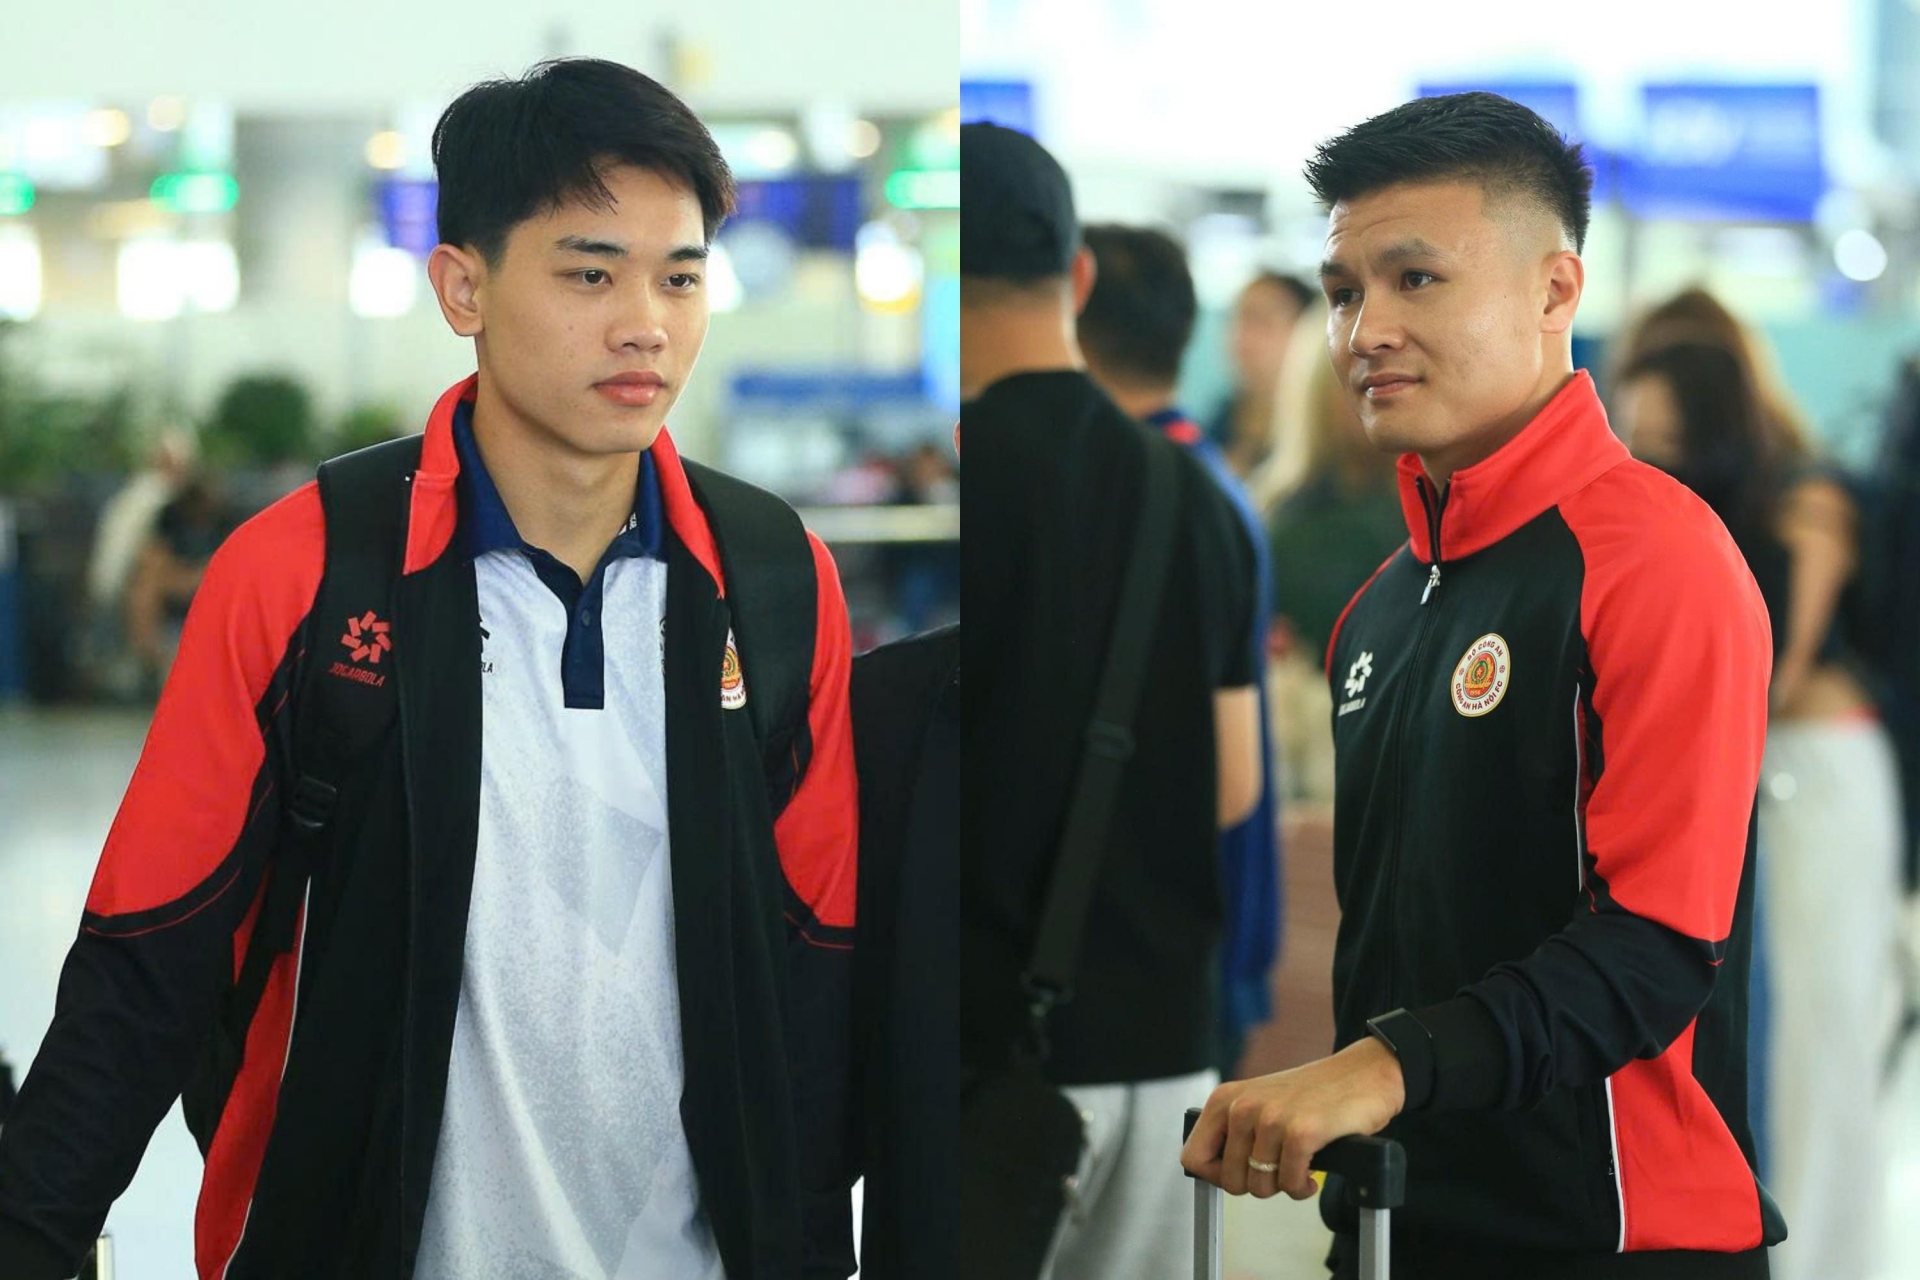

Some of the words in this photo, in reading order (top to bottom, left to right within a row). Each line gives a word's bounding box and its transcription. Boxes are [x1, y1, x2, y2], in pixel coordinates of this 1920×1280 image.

[1495, 645, 1503, 657] AN
[1462, 702, 1471, 710] AN
[1496, 681, 1503, 693] FC
